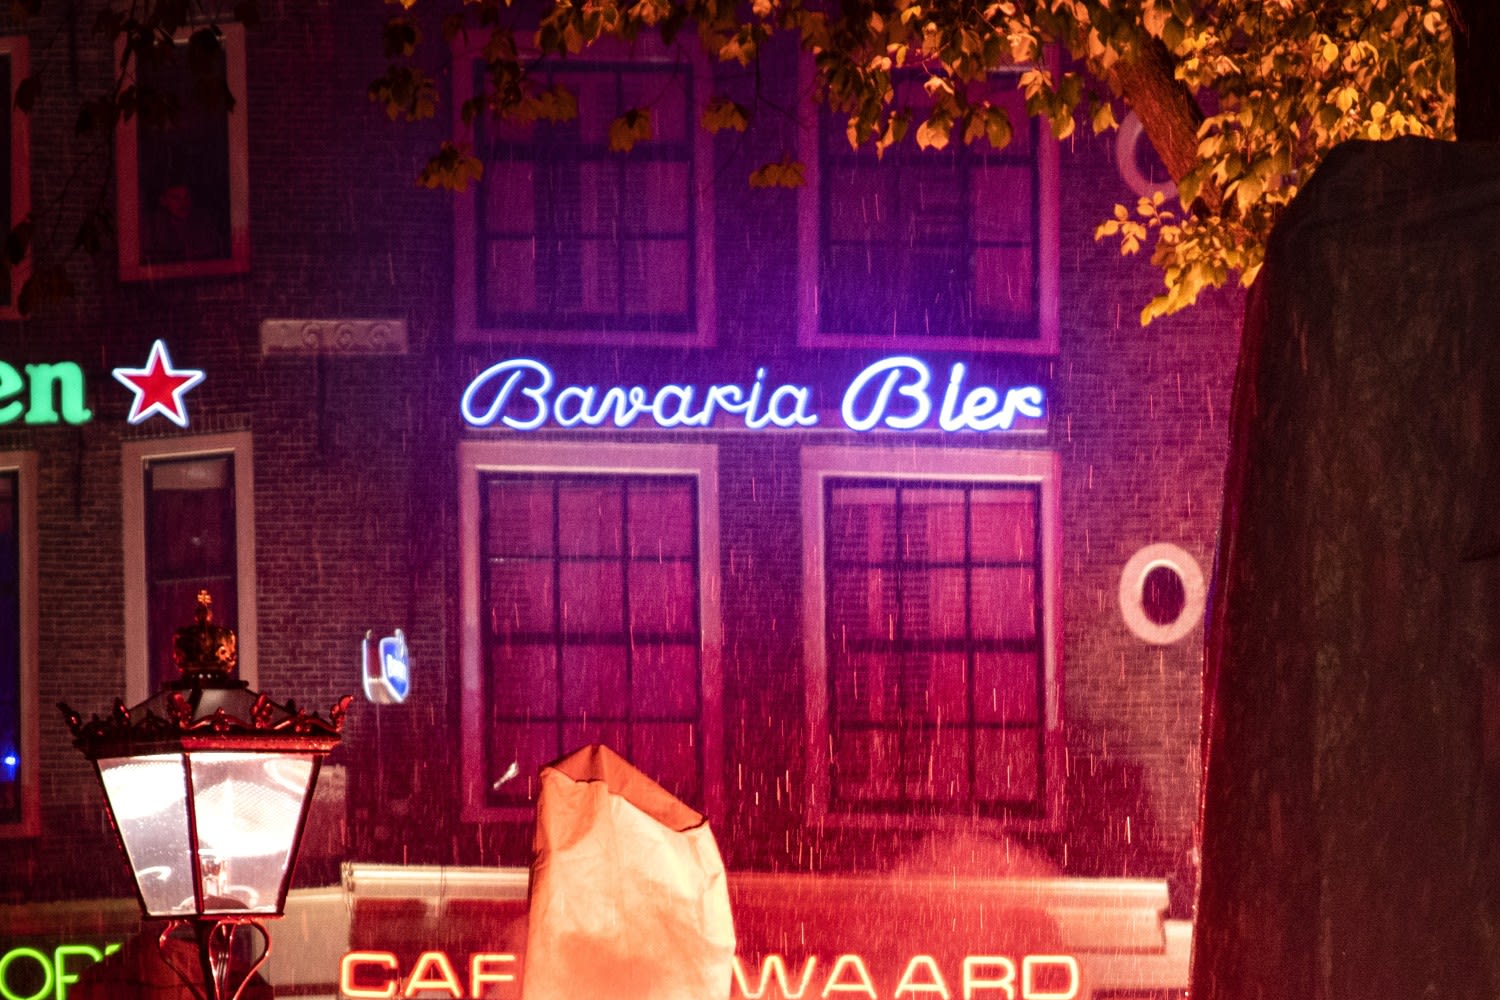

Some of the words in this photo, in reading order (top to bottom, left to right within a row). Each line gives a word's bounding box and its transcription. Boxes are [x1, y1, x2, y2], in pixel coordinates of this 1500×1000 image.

[460, 357, 818, 431] Bavaria
[841, 356, 1044, 432] Bier
[731, 954, 1081, 1000] WAARD
